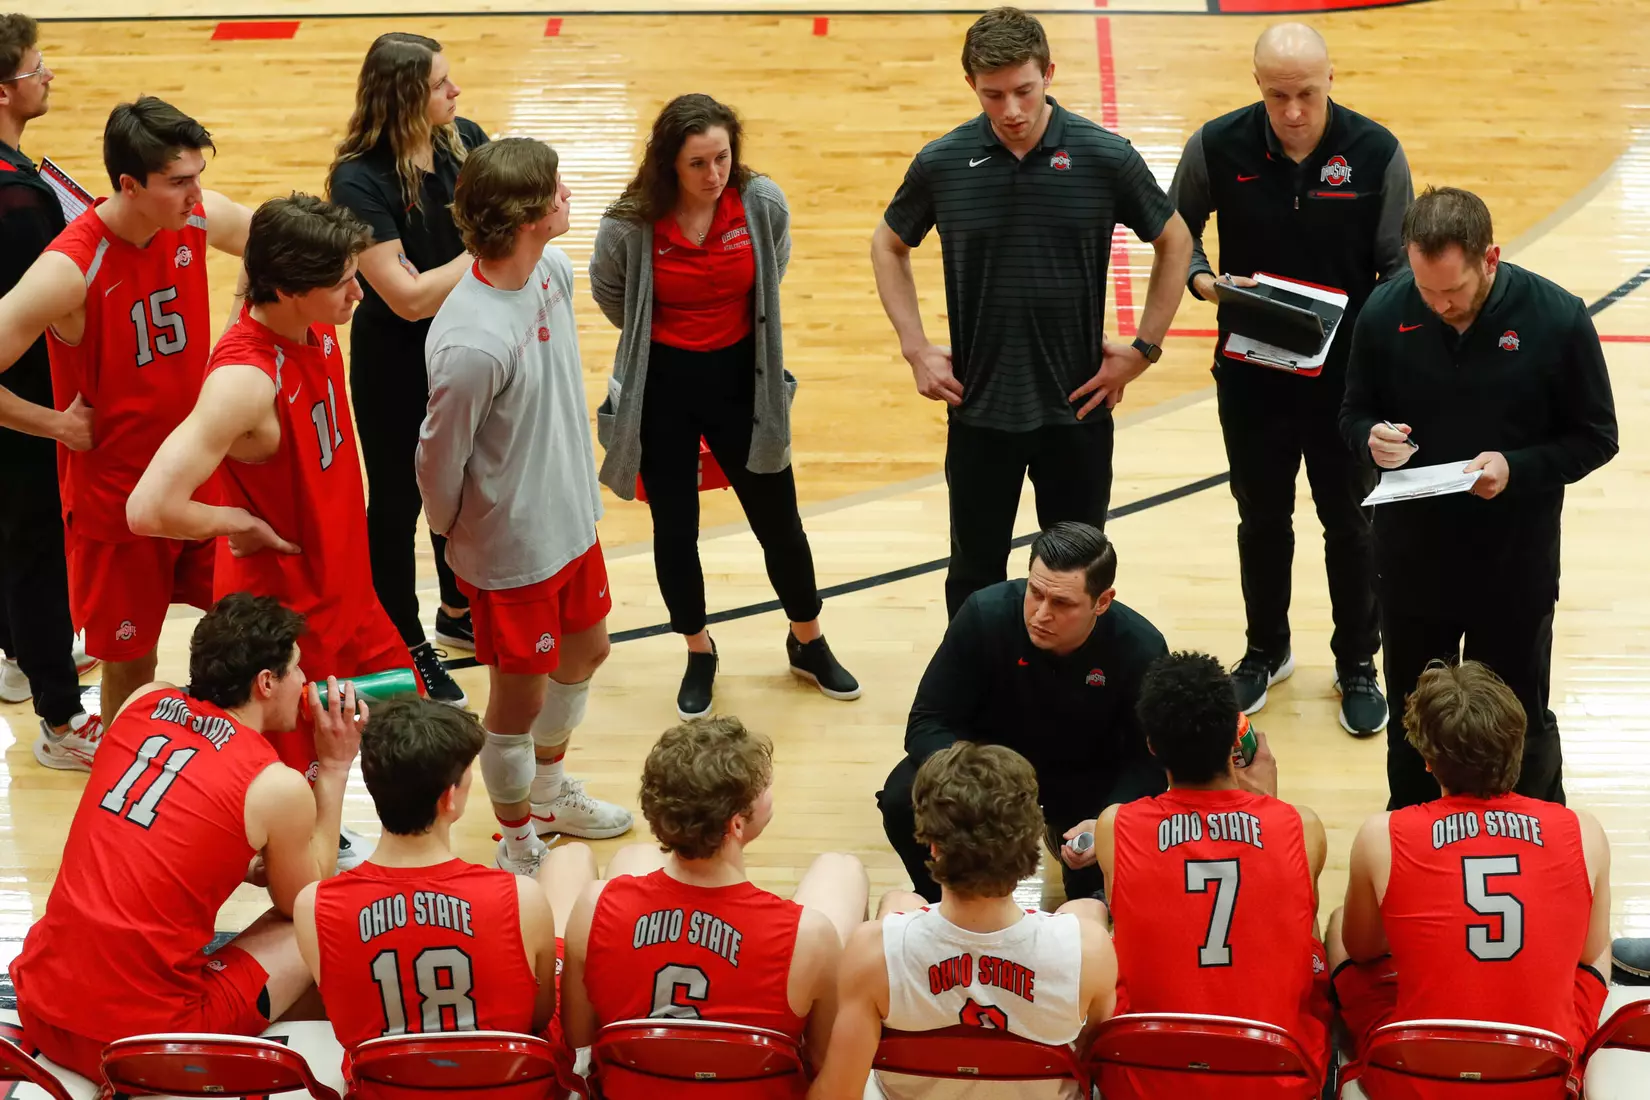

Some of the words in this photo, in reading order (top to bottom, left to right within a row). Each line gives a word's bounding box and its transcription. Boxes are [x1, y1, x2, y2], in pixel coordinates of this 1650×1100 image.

[130, 285, 187, 367] 15
[150, 696, 194, 726] OHIO
[191, 715, 236, 752] STATE
[98, 734, 200, 830] 11
[1158, 811, 1203, 852] OHIO
[1206, 811, 1264, 850] STATE
[1432, 811, 1480, 851] OHIO
[1484, 810, 1544, 848] STATE
[358, 892, 407, 943] OHIO
[413, 891, 475, 938] STATE
[632, 907, 684, 949] OHIO
[687, 909, 743, 968] STATE
[1184, 858, 1240, 968] 7
[1461, 854, 1524, 962] 5
[369, 945, 480, 1035] 18
[928, 953, 972, 996] OHIO
[978, 955, 1035, 1003] STATE
